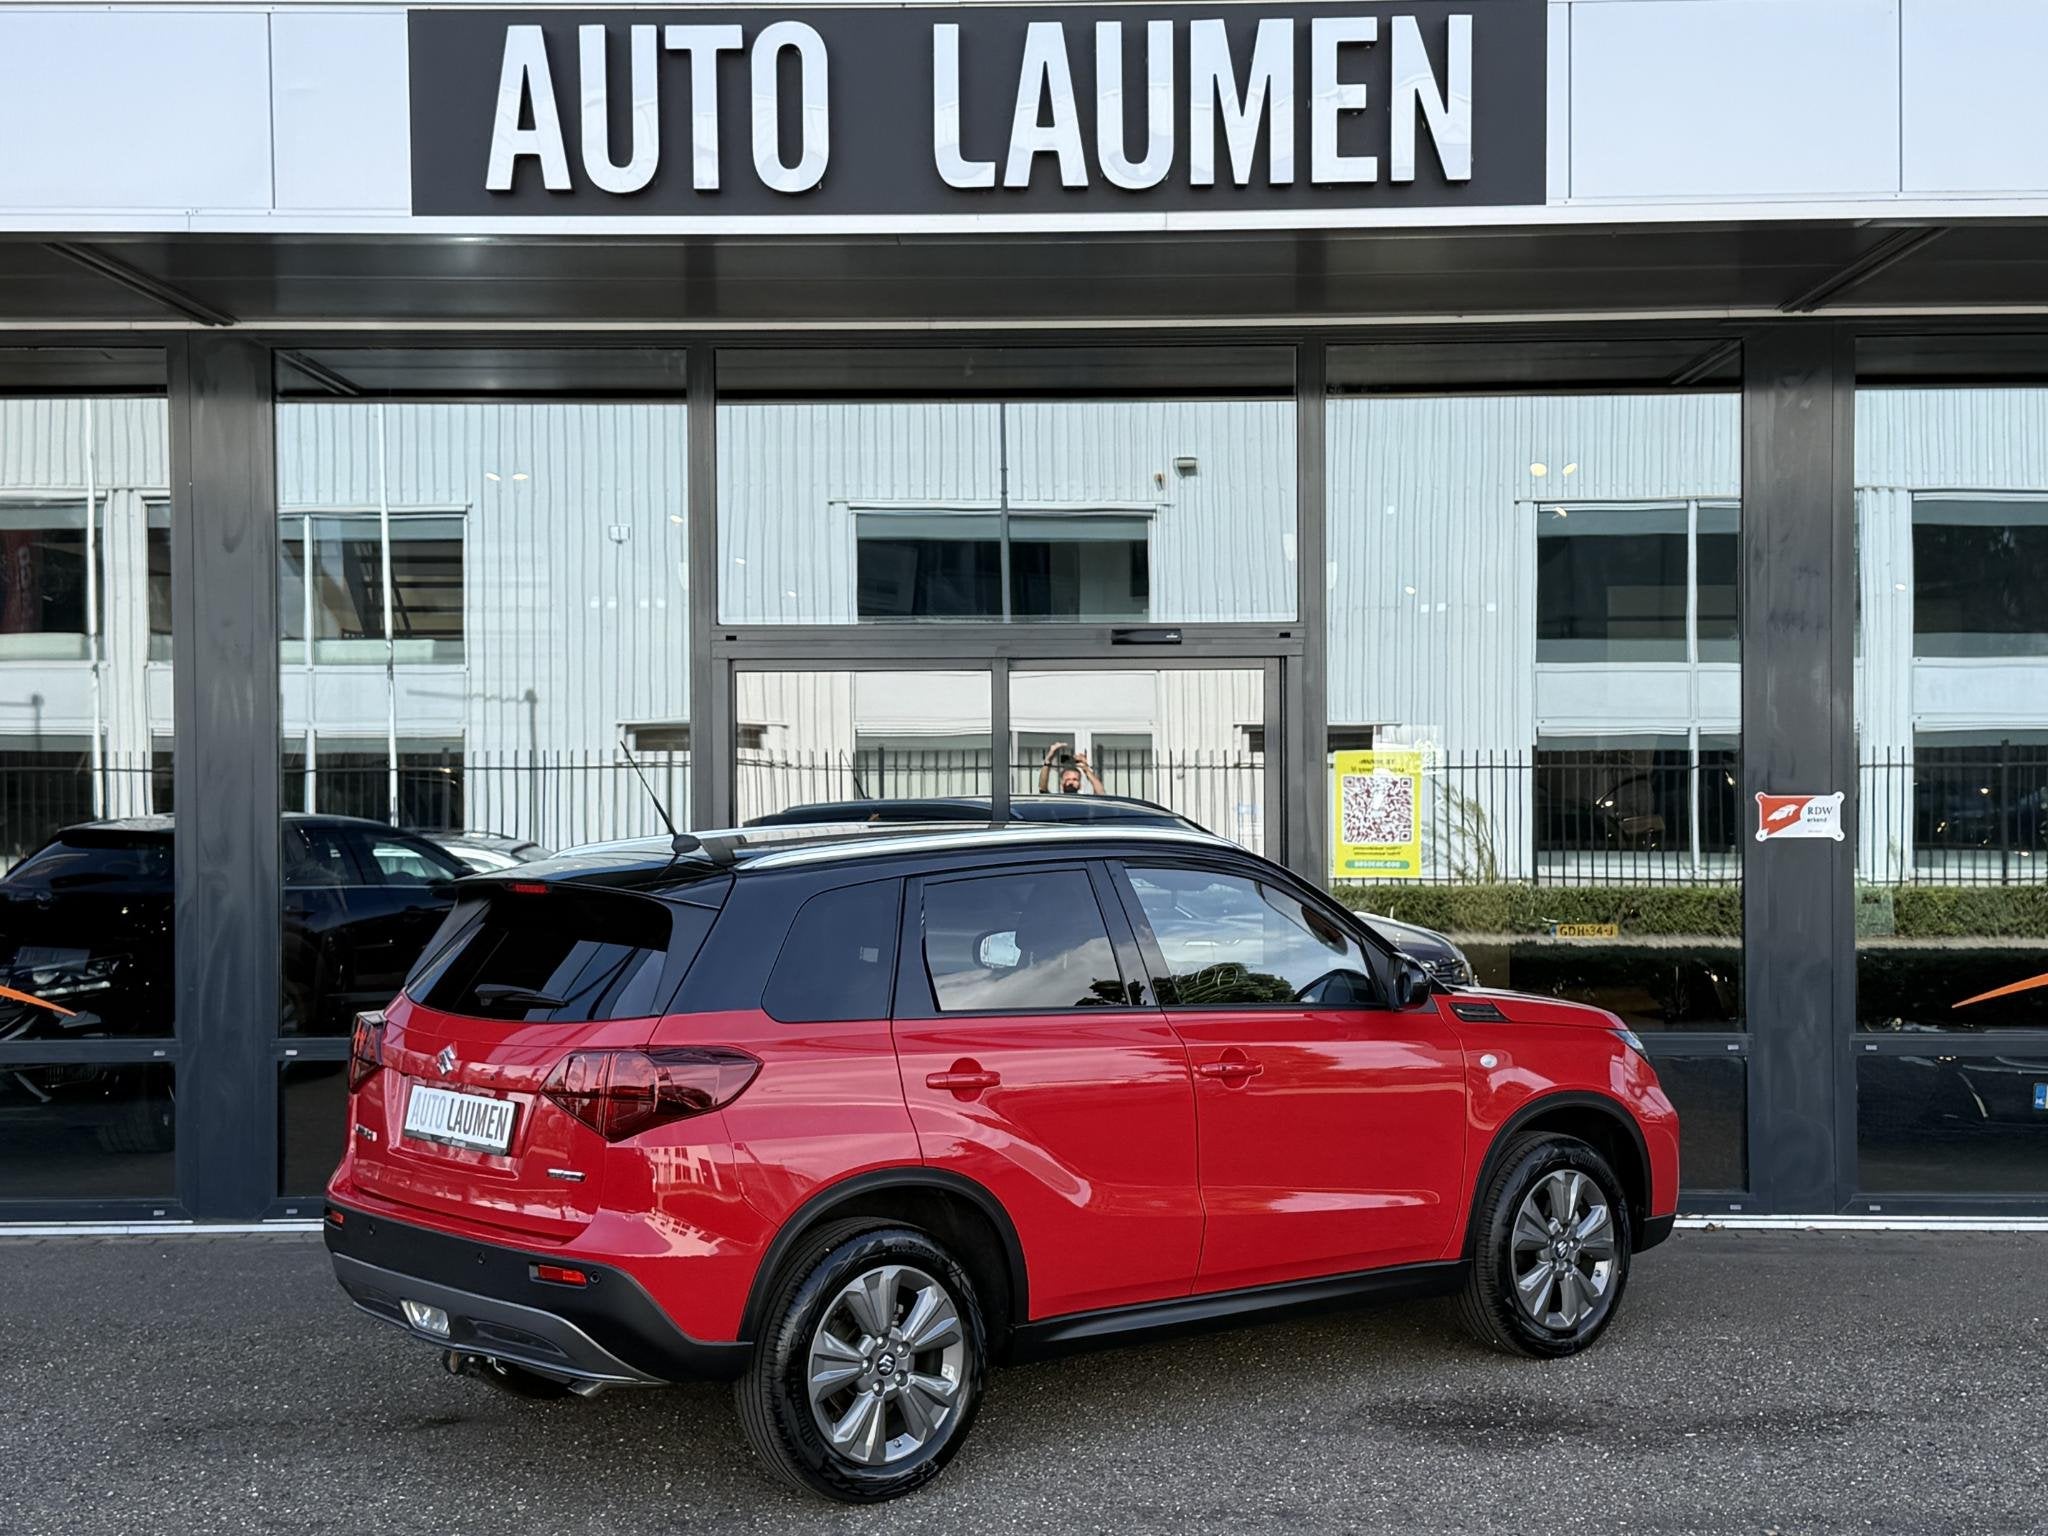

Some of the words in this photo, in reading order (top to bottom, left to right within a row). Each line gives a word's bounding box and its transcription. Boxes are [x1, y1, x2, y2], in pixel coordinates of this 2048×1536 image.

[486, 20, 829, 194] AUTO
[933, 14, 1473, 190] LAUMEN
[1807, 806, 1833, 815] RDW
[410, 1091, 447, 1129] AUTO
[446, 1097, 510, 1141] LAUMEN
